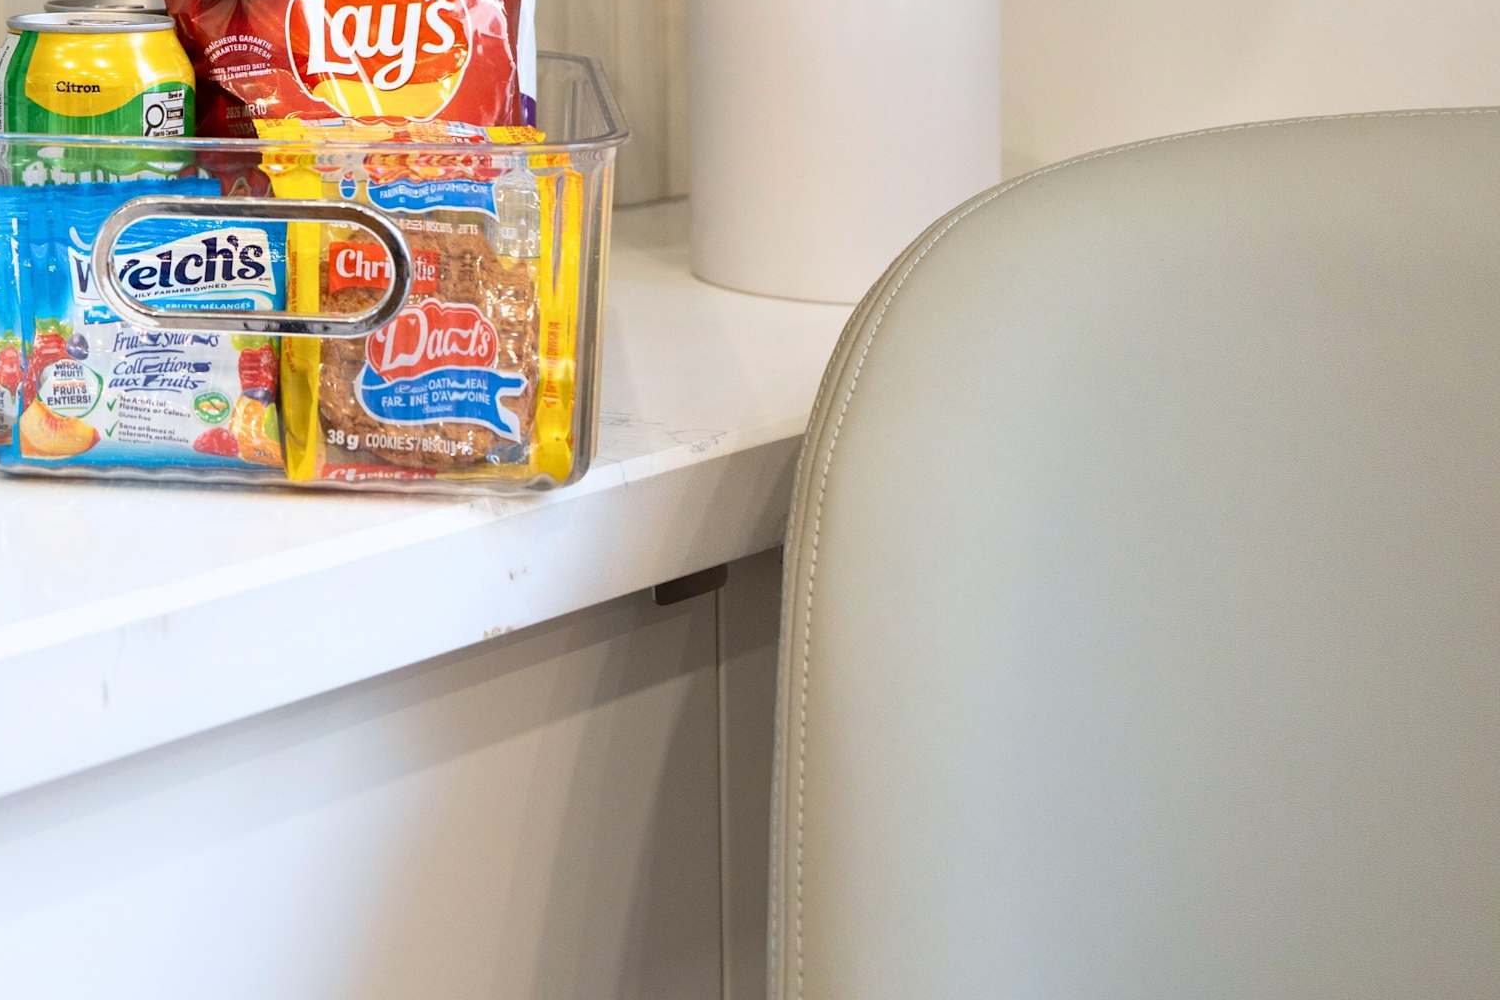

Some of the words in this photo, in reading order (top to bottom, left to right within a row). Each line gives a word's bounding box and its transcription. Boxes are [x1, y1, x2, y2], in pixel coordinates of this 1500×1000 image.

[209, 44, 248, 63] UARANTEED
[249, 45, 273, 60] FRESH
[55, 81, 101, 94] Citron
[336, 248, 436, 283] Chritie
[154, 287, 192, 296] FARMER
[193, 283, 228, 293] OWNED
[108, 378, 139, 388] aux
[143, 374, 199, 390] Fruits
[47, 396, 91, 406] ENTIERS!
[327, 429, 345, 445] 38
[346, 433, 359, 450] g
